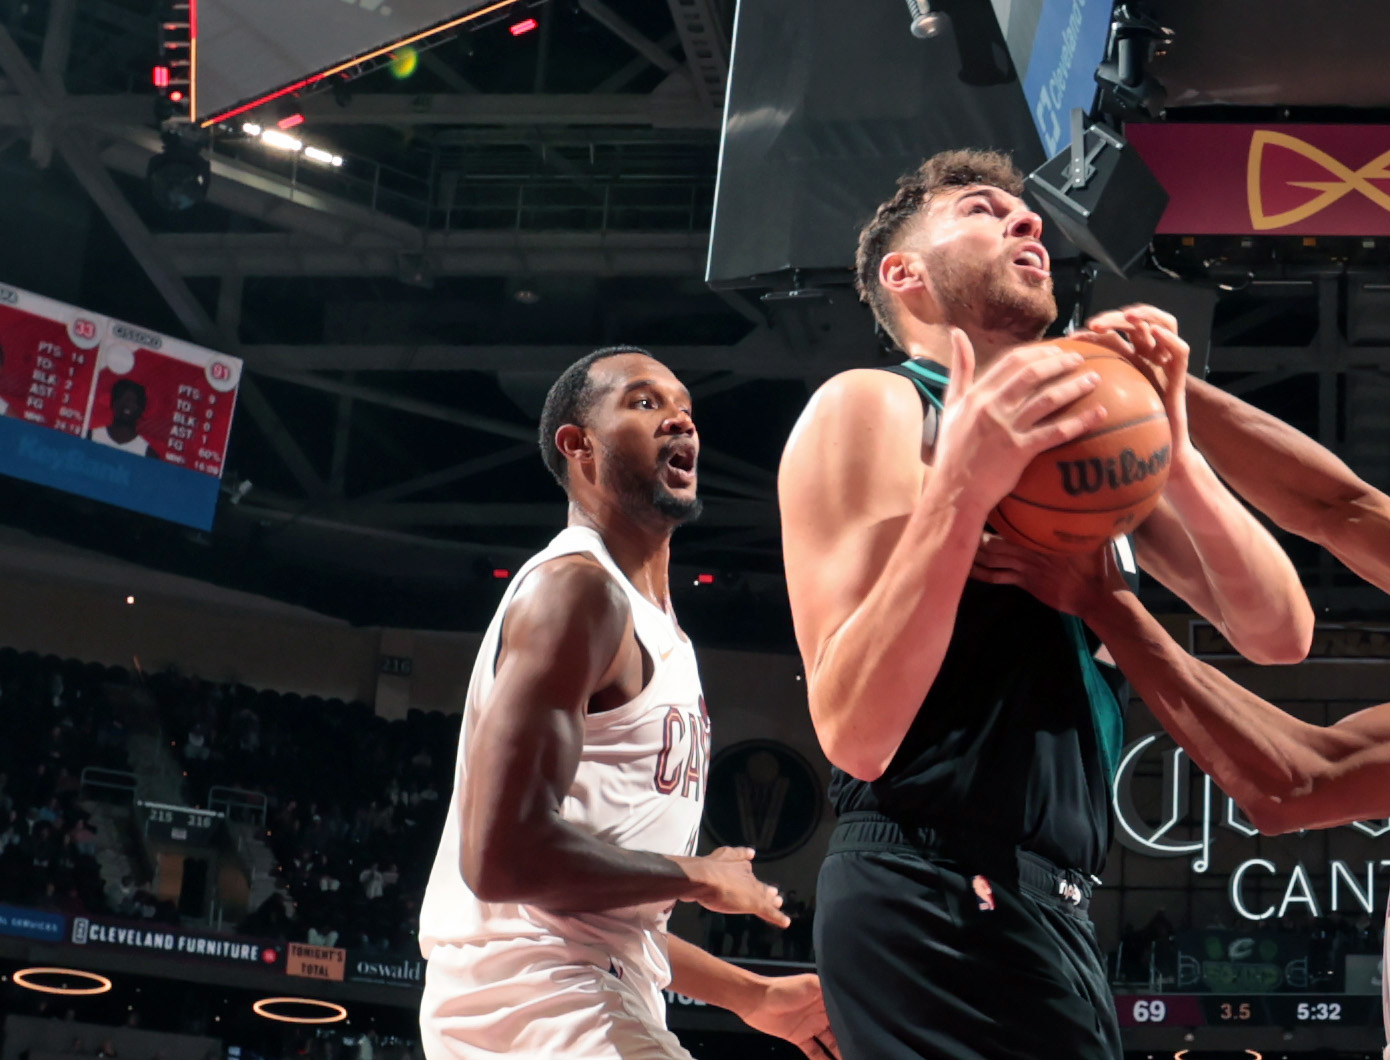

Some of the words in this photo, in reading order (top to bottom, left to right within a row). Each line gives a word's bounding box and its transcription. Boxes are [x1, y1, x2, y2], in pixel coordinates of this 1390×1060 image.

[75, 319, 96, 338] 33
[212, 363, 230, 380] 91
[1057, 445, 1170, 497] Wilson
[89, 923, 174, 950] CLEVELAND
[177, 935, 259, 962] FURNITURE
[301, 962, 329, 978] TOTAL
[356, 960, 421, 981] oswald
[1132, 1000, 1166, 1023] 69
[1220, 1003, 1251, 1020] 3.5
[1297, 1002, 1341, 1021] 5:32
